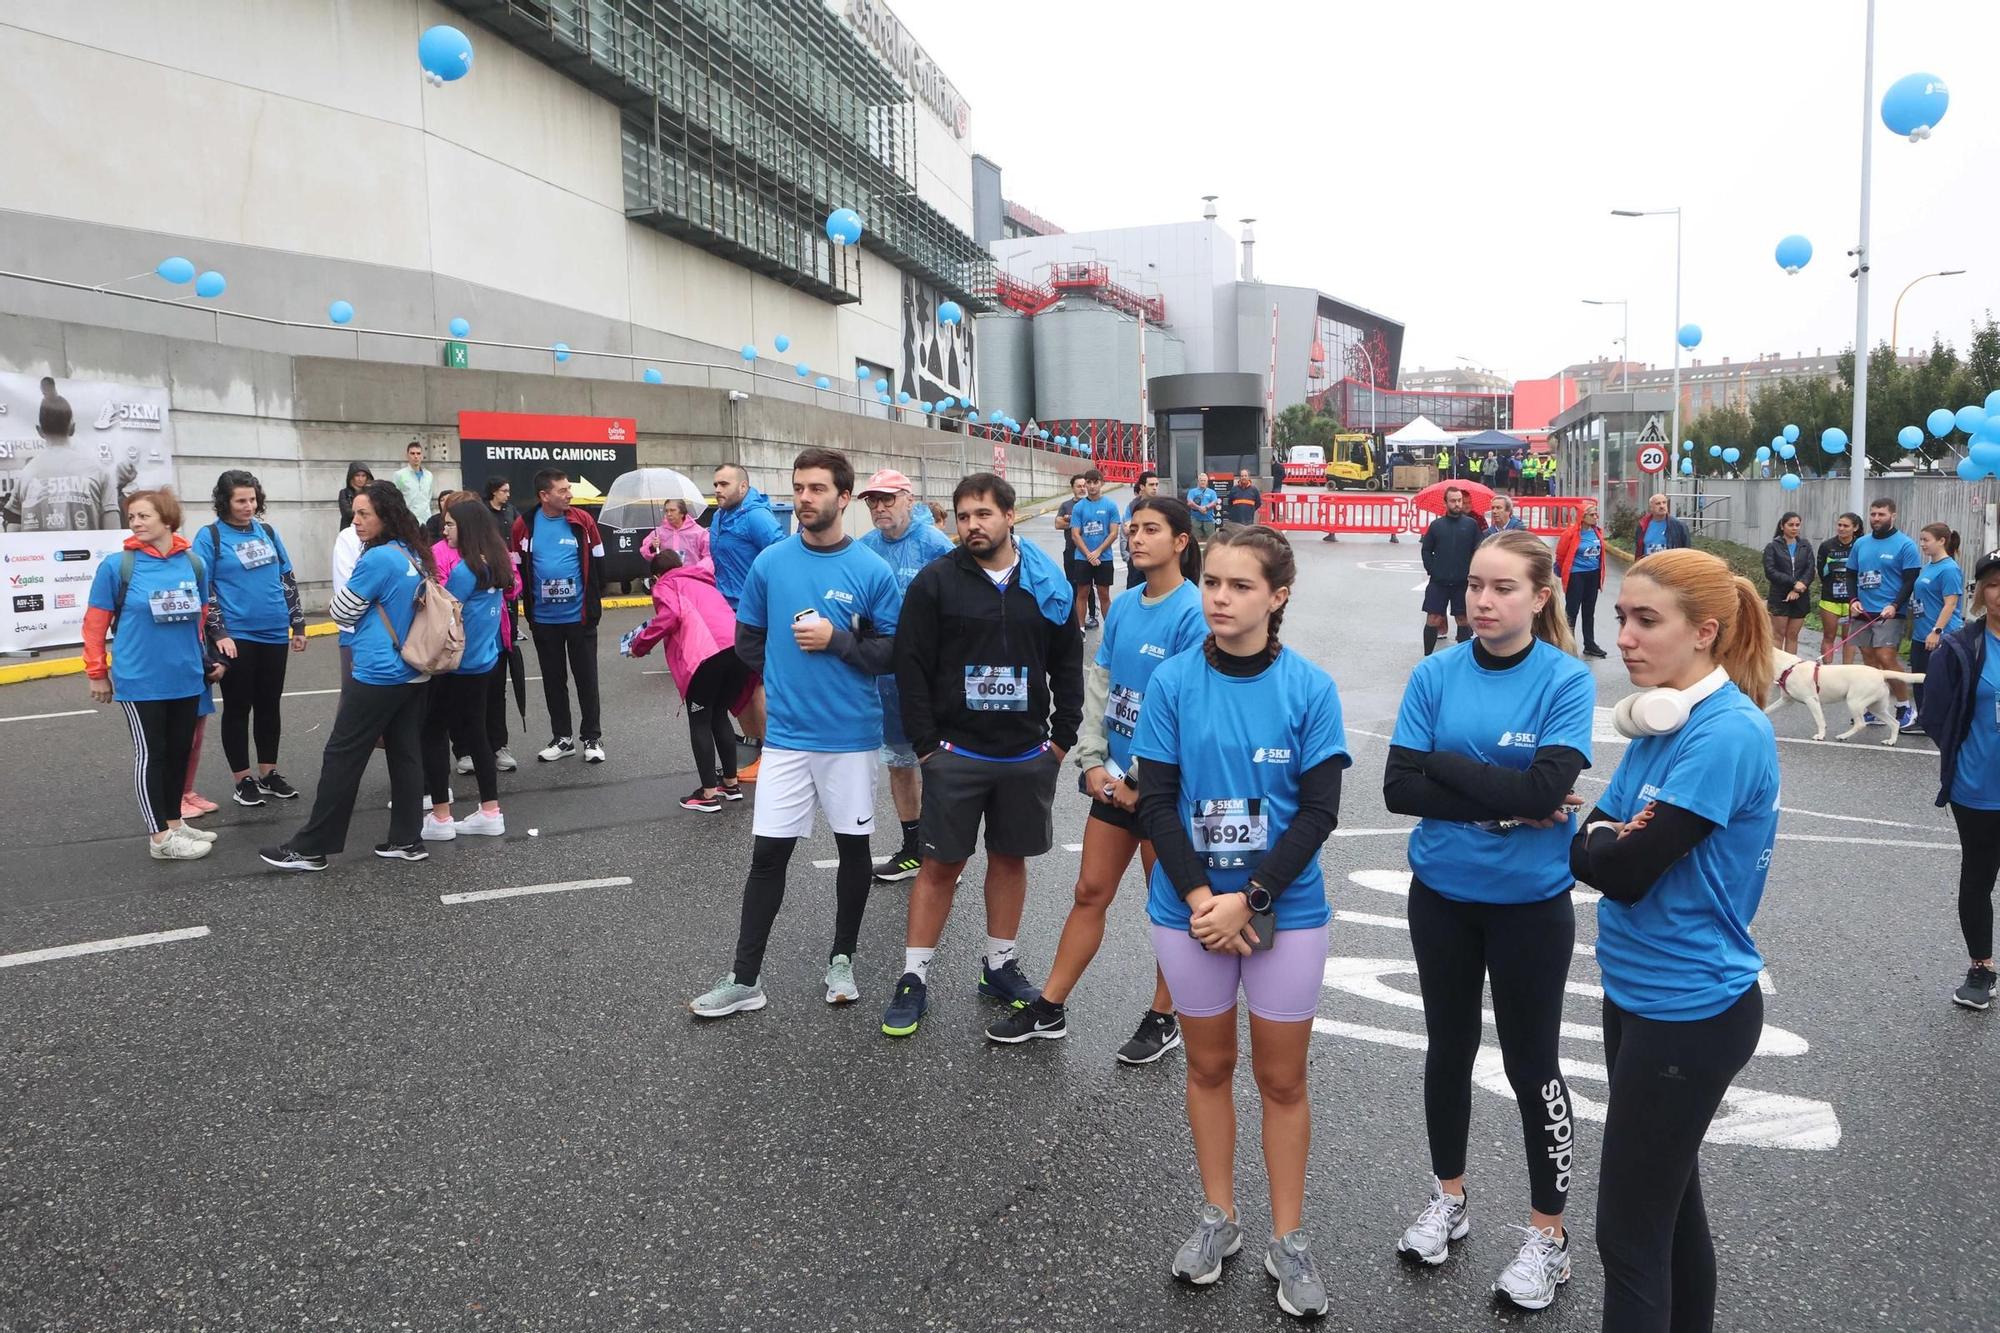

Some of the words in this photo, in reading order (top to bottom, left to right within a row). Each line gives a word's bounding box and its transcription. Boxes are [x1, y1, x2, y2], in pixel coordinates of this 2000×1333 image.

[119, 402, 160, 419] 5KM
[487, 446, 550, 461] ENTRADA
[552, 447, 617, 461] CAMIONES
[1643, 453, 1662, 464] 20
[246, 548, 267, 560] 0937
[548, 587, 570, 595] 0950
[161, 601, 190, 611] 0936
[977, 683, 1015, 695] 0609
[1115, 702, 1140, 723] 0610
[1268, 748, 1291, 759] 5KM
[1217, 801, 1244, 810] 5KM
[1541, 1079, 1573, 1192] adidas
